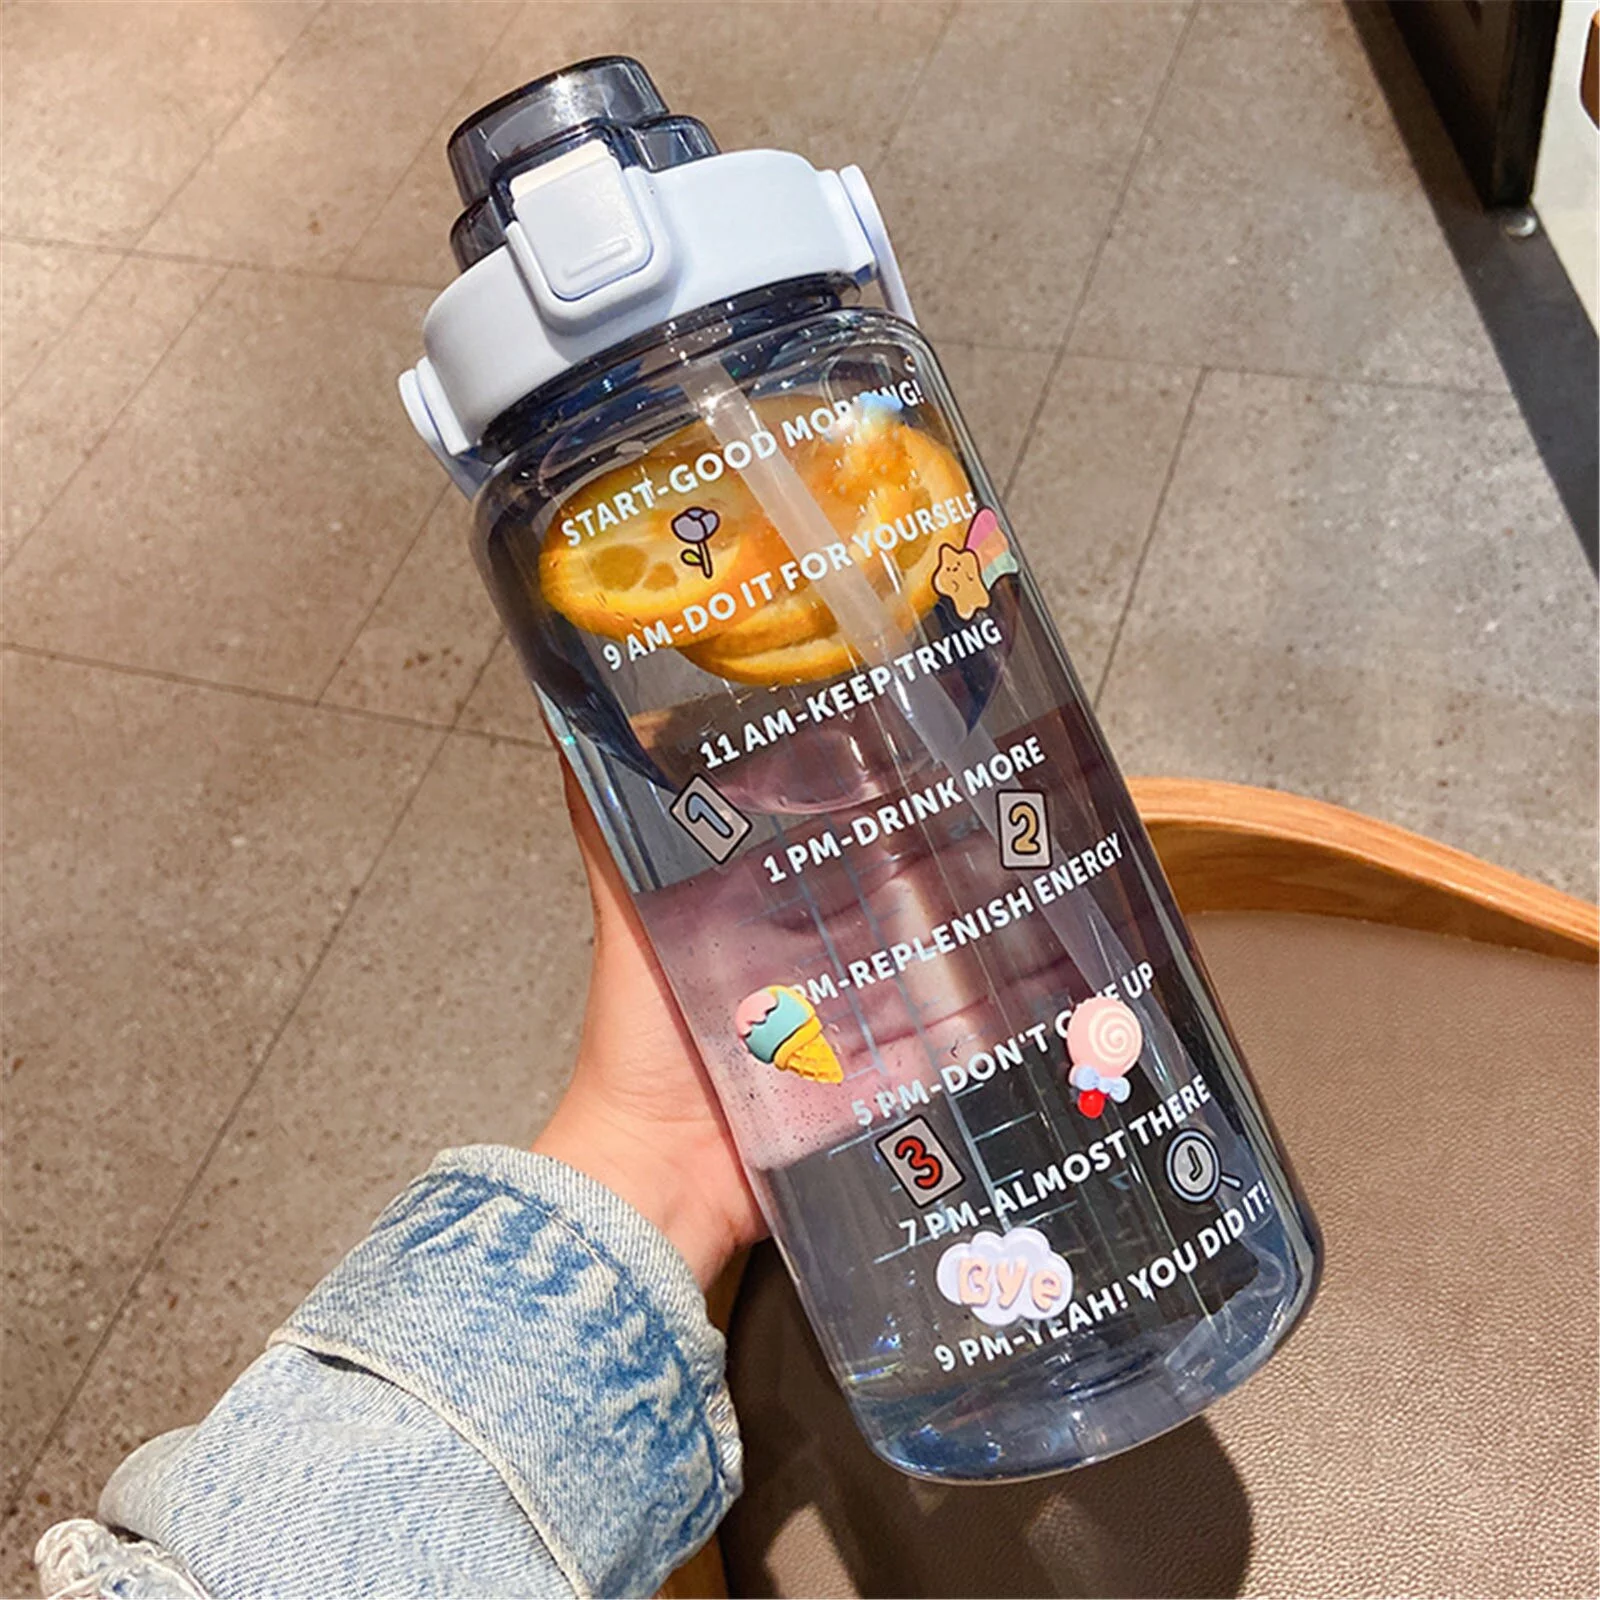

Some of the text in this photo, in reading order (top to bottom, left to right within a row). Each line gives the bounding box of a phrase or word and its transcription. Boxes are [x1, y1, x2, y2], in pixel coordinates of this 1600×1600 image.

[561, 430, 777, 547] START-GOOD
[602, 645, 621, 671] 9
[625, 593, 736, 662] AM-DO
[740, 574, 773, 608] IT
[779, 544, 853, 590] FOR
[699, 618, 1002, 769] 11 AM-KEEP TRYING
[762, 736, 1046, 884] 1 PM-DRINK MORE
[1007, 800, 1041, 856] 2
[1032, 832, 1126, 904] ENERGY
[851, 1099, 873, 1126] 5
[876, 1023, 1048, 1118] PM-DON'T
[1121, 961, 1154, 999] UP
[894, 1135, 944, 1190] 3
[899, 1074, 1211, 1247] 7 PM-ALMOST THERE
[934, 1344, 956, 1371] 9
[1127, 1242, 1199, 1296] YOU
[1197, 1206, 1245, 1259] DID
[1242, 1182, 1272, 1222] IT!
[958, 1257, 1062, 1311] Bye
